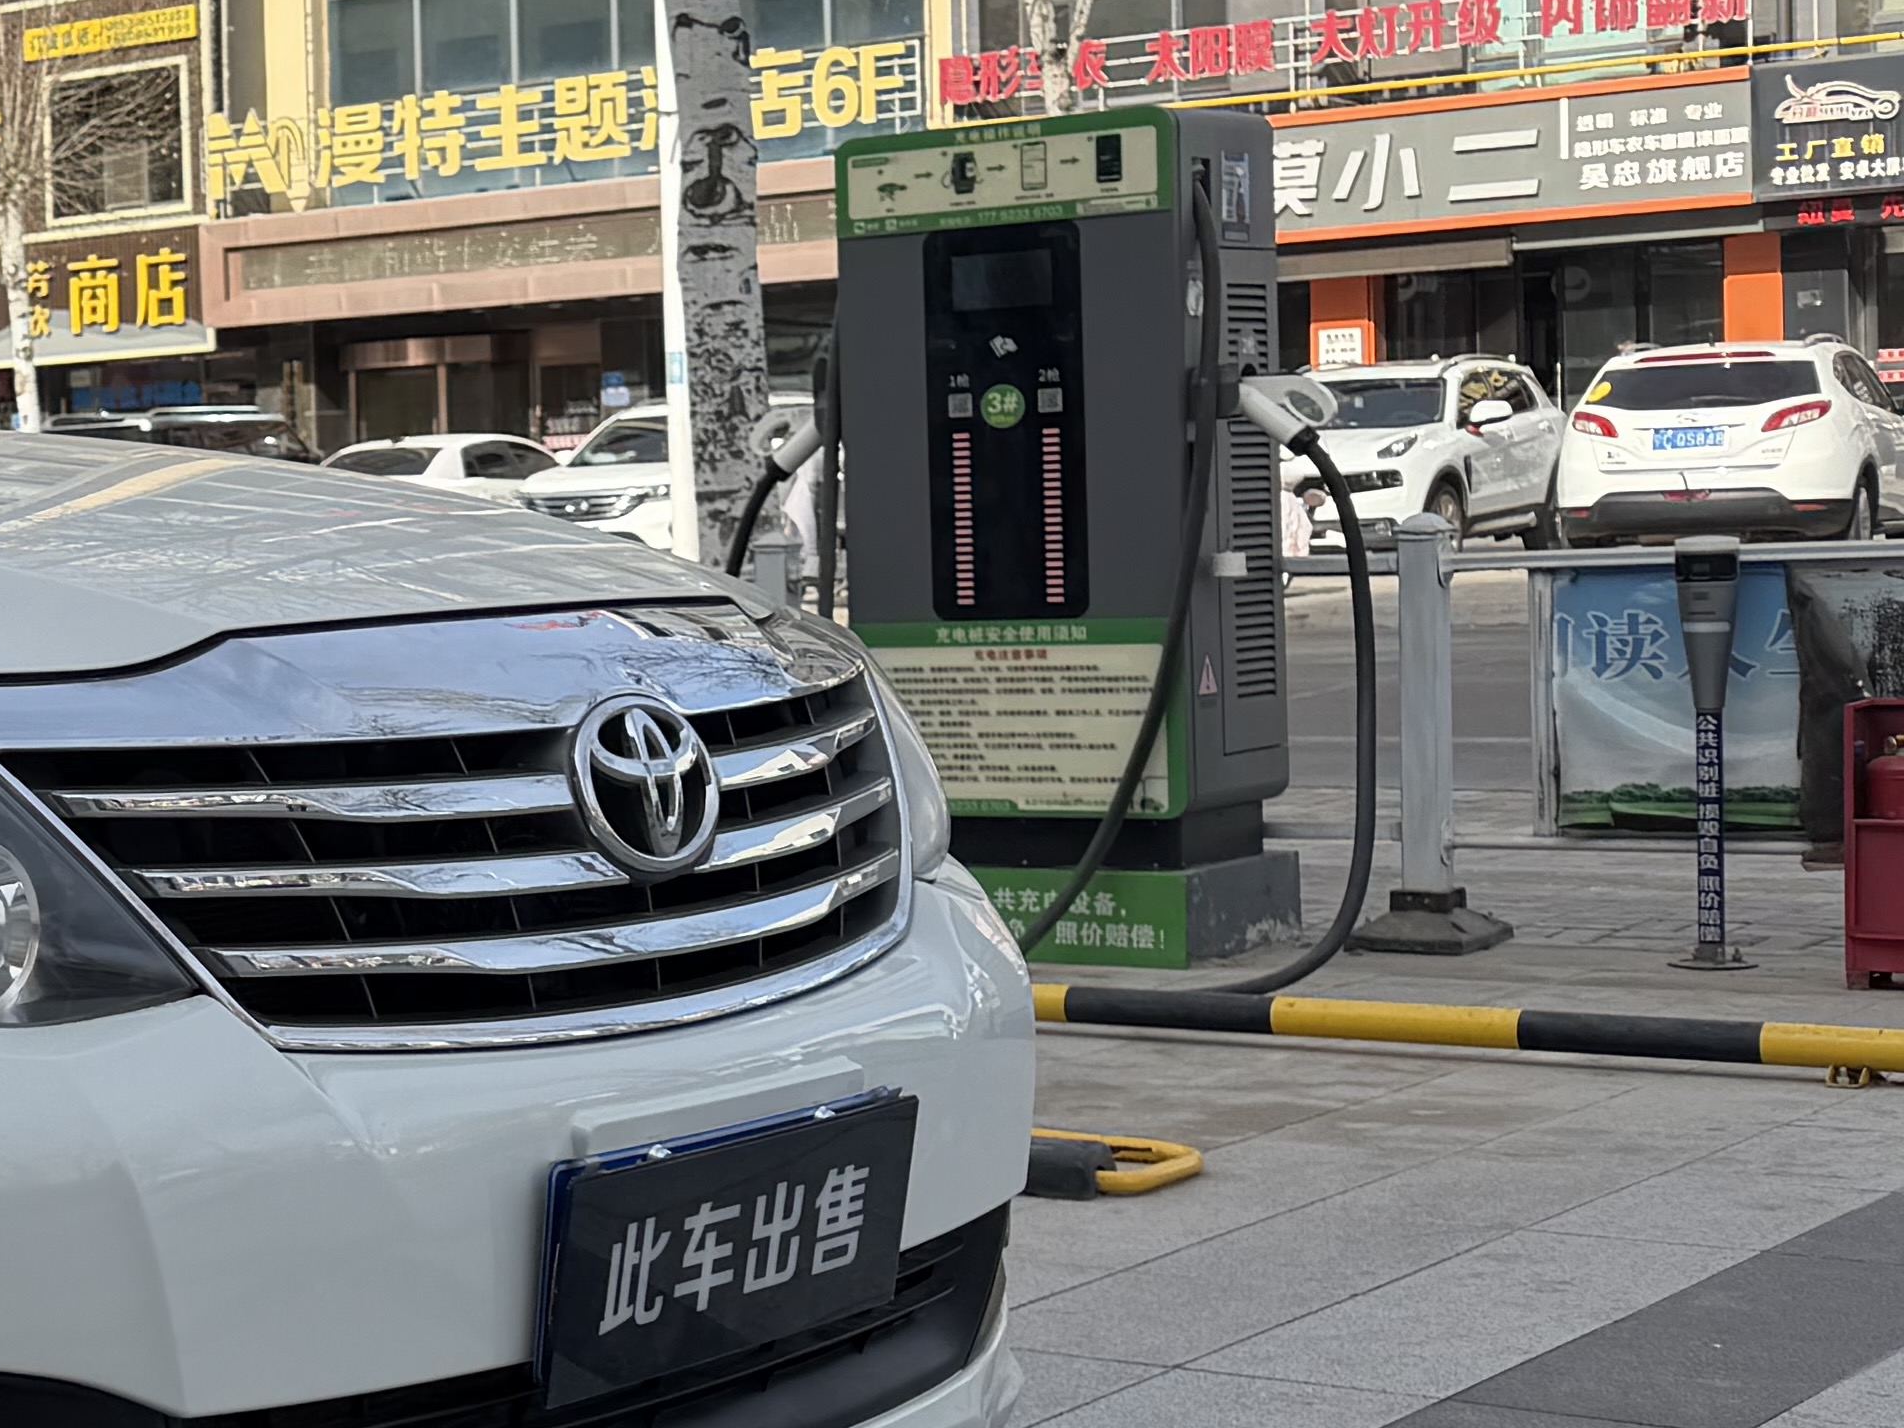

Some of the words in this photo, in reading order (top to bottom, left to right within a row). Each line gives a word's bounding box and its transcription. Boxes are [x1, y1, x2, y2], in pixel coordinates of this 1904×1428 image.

[1146, 19, 1276, 82] 太阳膜
[1775, 133, 1884, 161] 工厂直销
[1579, 151, 1744, 190] 吴忠旗舰店
[1839, 157, 1904, 180] 安卓大屏
[67, 247, 187, 336] 商店
[987, 391, 1019, 413] 3#
[935, 625, 1087, 643] 充电桩安全使用须知
[1055, 919, 1165, 949] 照价赔偿!
[598, 1164, 870, 1336] 此车出售
